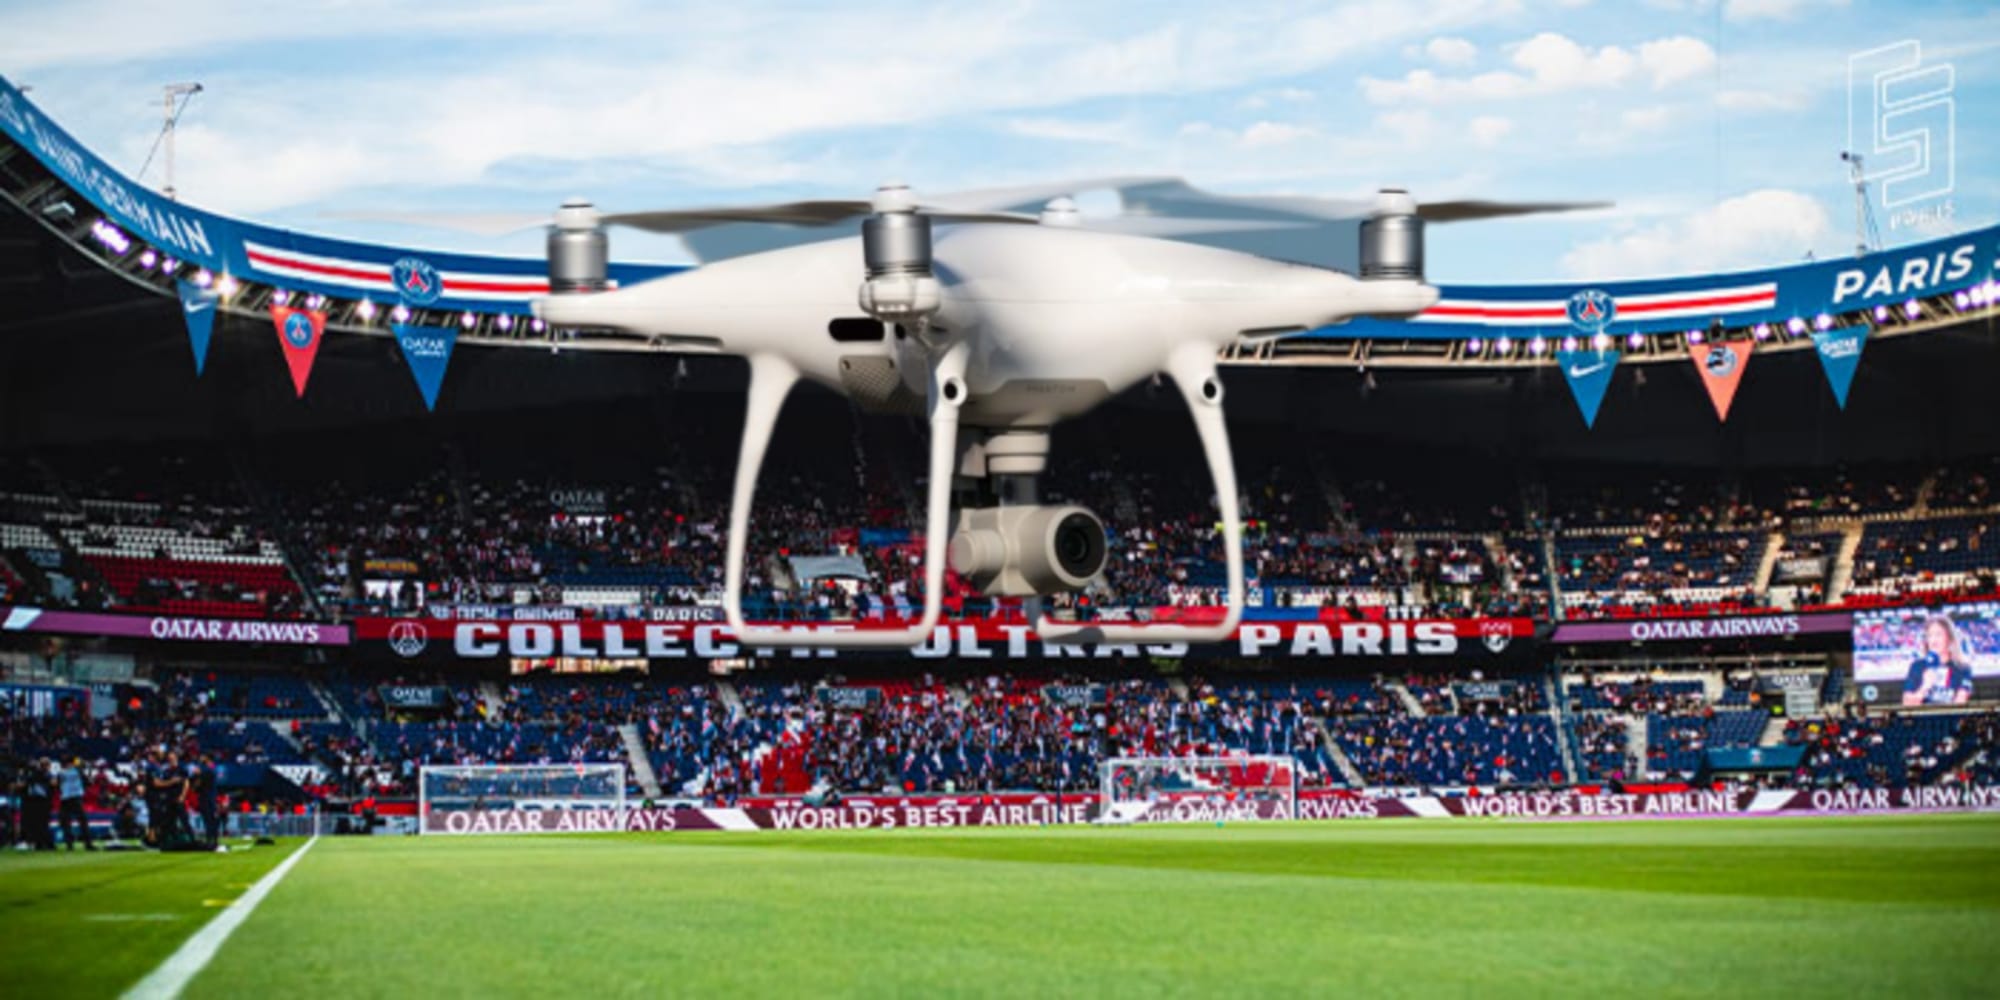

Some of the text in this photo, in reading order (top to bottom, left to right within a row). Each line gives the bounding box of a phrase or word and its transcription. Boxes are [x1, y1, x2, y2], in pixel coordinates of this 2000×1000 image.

[1832, 245, 1976, 303] PARIS
[151, 617, 320, 643] QATAR AIRWAYS
[1239, 621, 1459, 656] PARIS
[1631, 615, 1800, 640] QATAR AIRWAYS
[1271, 799, 1378, 819] ARWAYS
[1461, 792, 1739, 816] WORLD'S BEST AIRLINE
[1811, 788, 1890, 810] QATAR
[445, 807, 677, 833] QATAR AIRWAYS
[769, 802, 1088, 830] WORLD'S BEST AIRLINE
